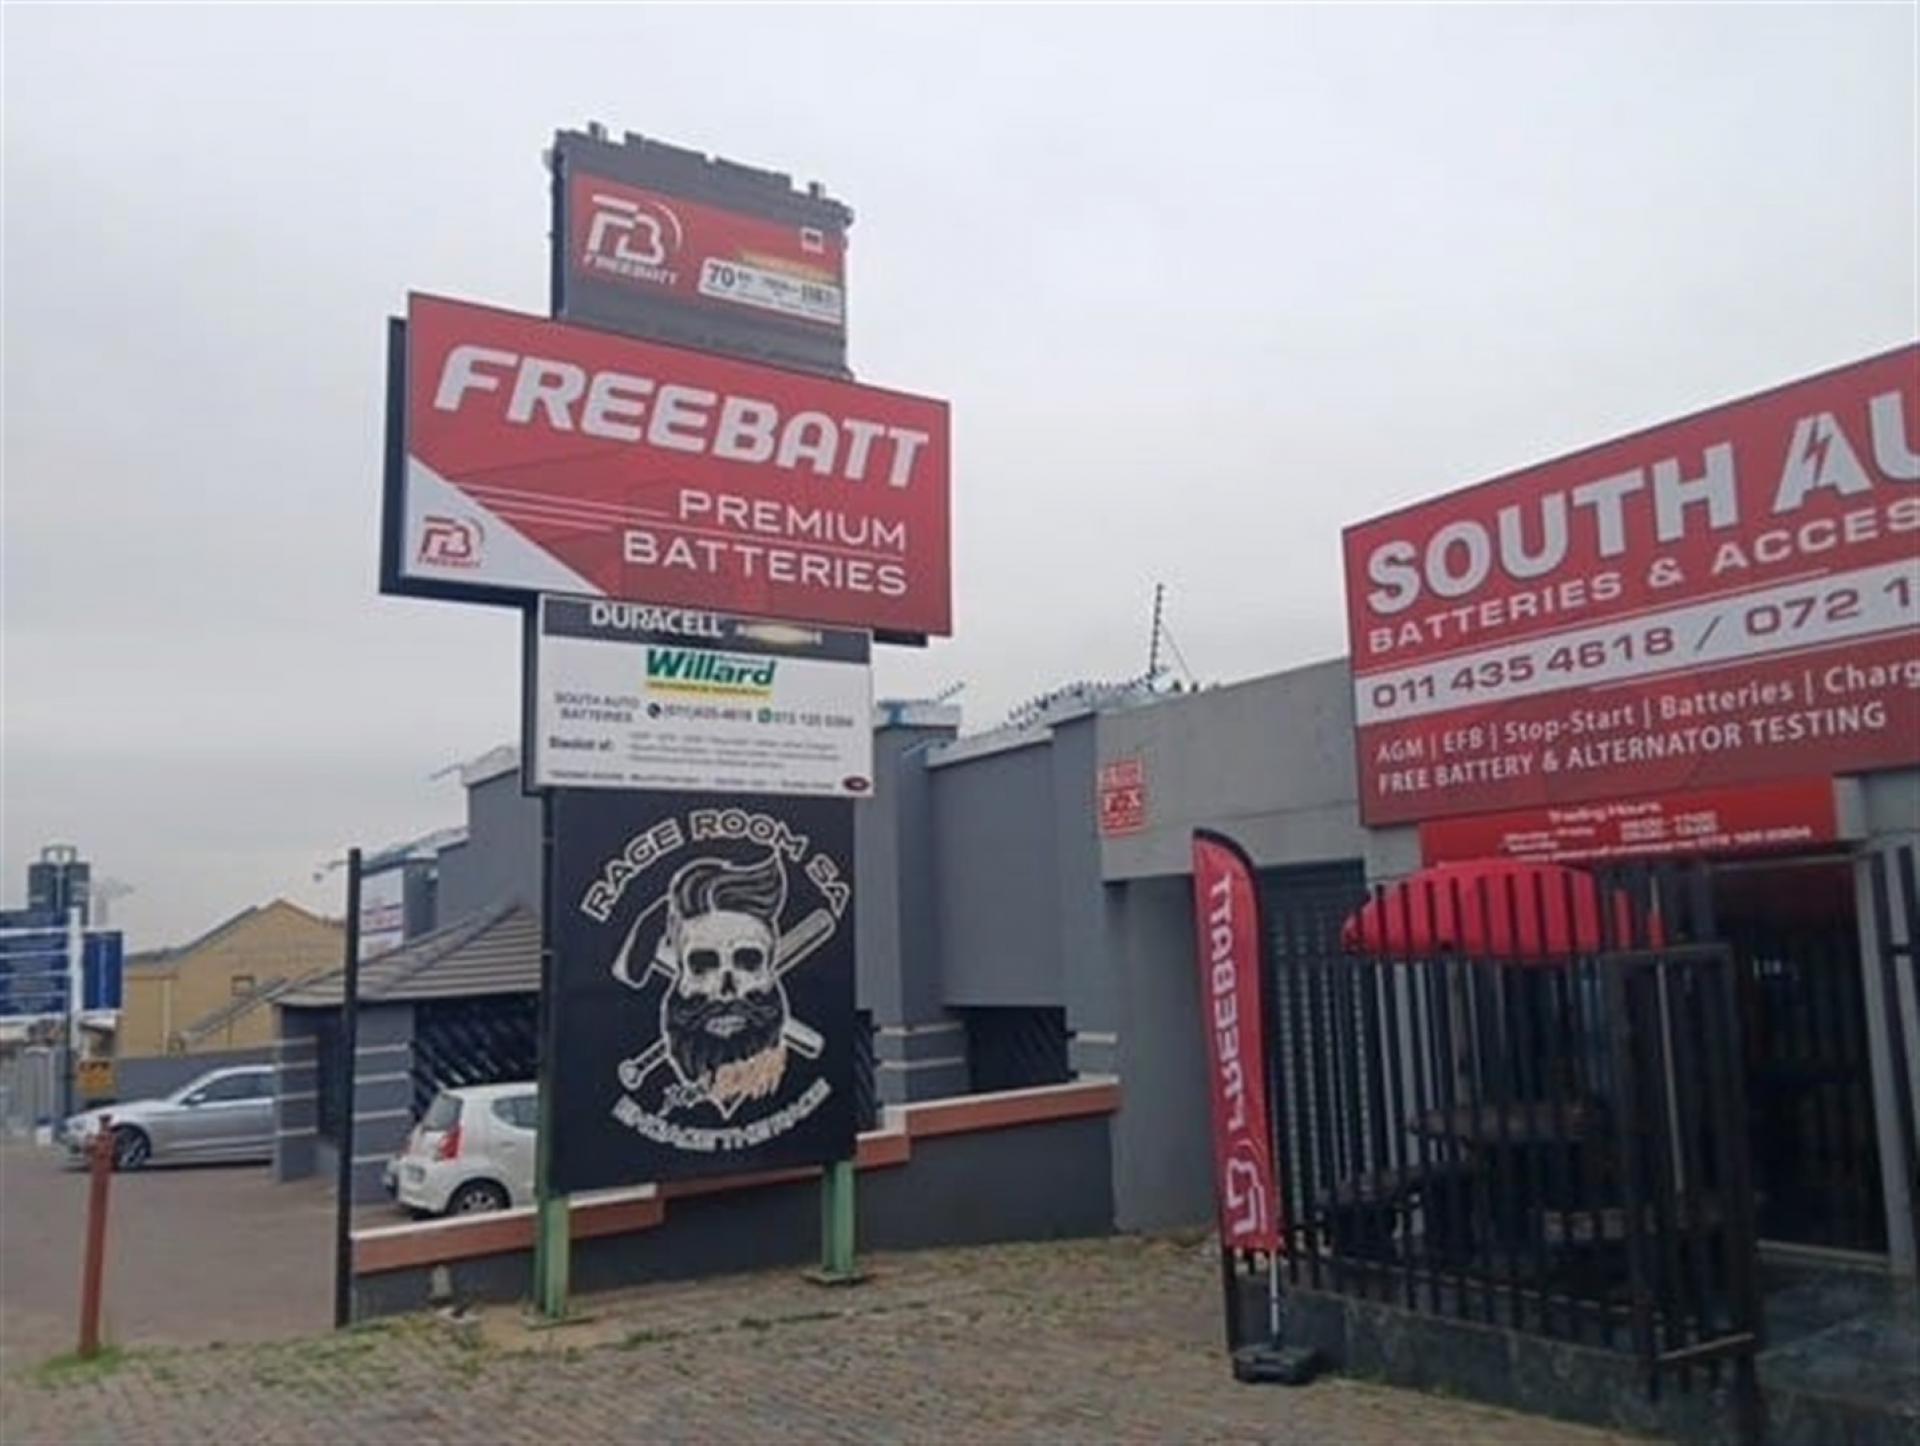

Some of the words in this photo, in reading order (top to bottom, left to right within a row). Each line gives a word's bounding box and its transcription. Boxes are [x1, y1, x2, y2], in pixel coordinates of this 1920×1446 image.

[707, 262, 735, 289] 70
[433, 344, 929, 488] FREEBATT
[679, 488, 906, 550] PREMIUM
[1367, 441, 1738, 615] SOUTH
[1773, 391, 1920, 515] AU
[623, 531, 907, 595] BATTERIES
[1368, 571, 1622, 653] BATTERIES
[1648, 557, 1684, 589] &
[1711, 498, 1920, 575] ACCES
[590, 603, 723, 637] DURACELL
[1372, 675, 1435, 709] 011
[1450, 655, 1536, 691] 435
[1545, 626, 1675, 672] 4618
[1744, 588, 1861, 636] 072
[647, 648, 777, 686] Willard
[1376, 735, 1424, 763] AGM
[1442, 726, 1485, 752] EFB
[1504, 704, 1635, 744] Stop-Start
[1659, 679, 1794, 720] Batteries
[1378, 768, 1431, 795] FREE
[1434, 752, 1534, 787] BATTERY
[1541, 751, 1560, 773] &
[1566, 722, 1743, 769] ALTERNATOR
[1749, 701, 1887, 744] TESTING
[580, 817, 684, 922] RAGE
[689, 809, 809, 861] ROOM
[804, 853, 851, 919] SA
